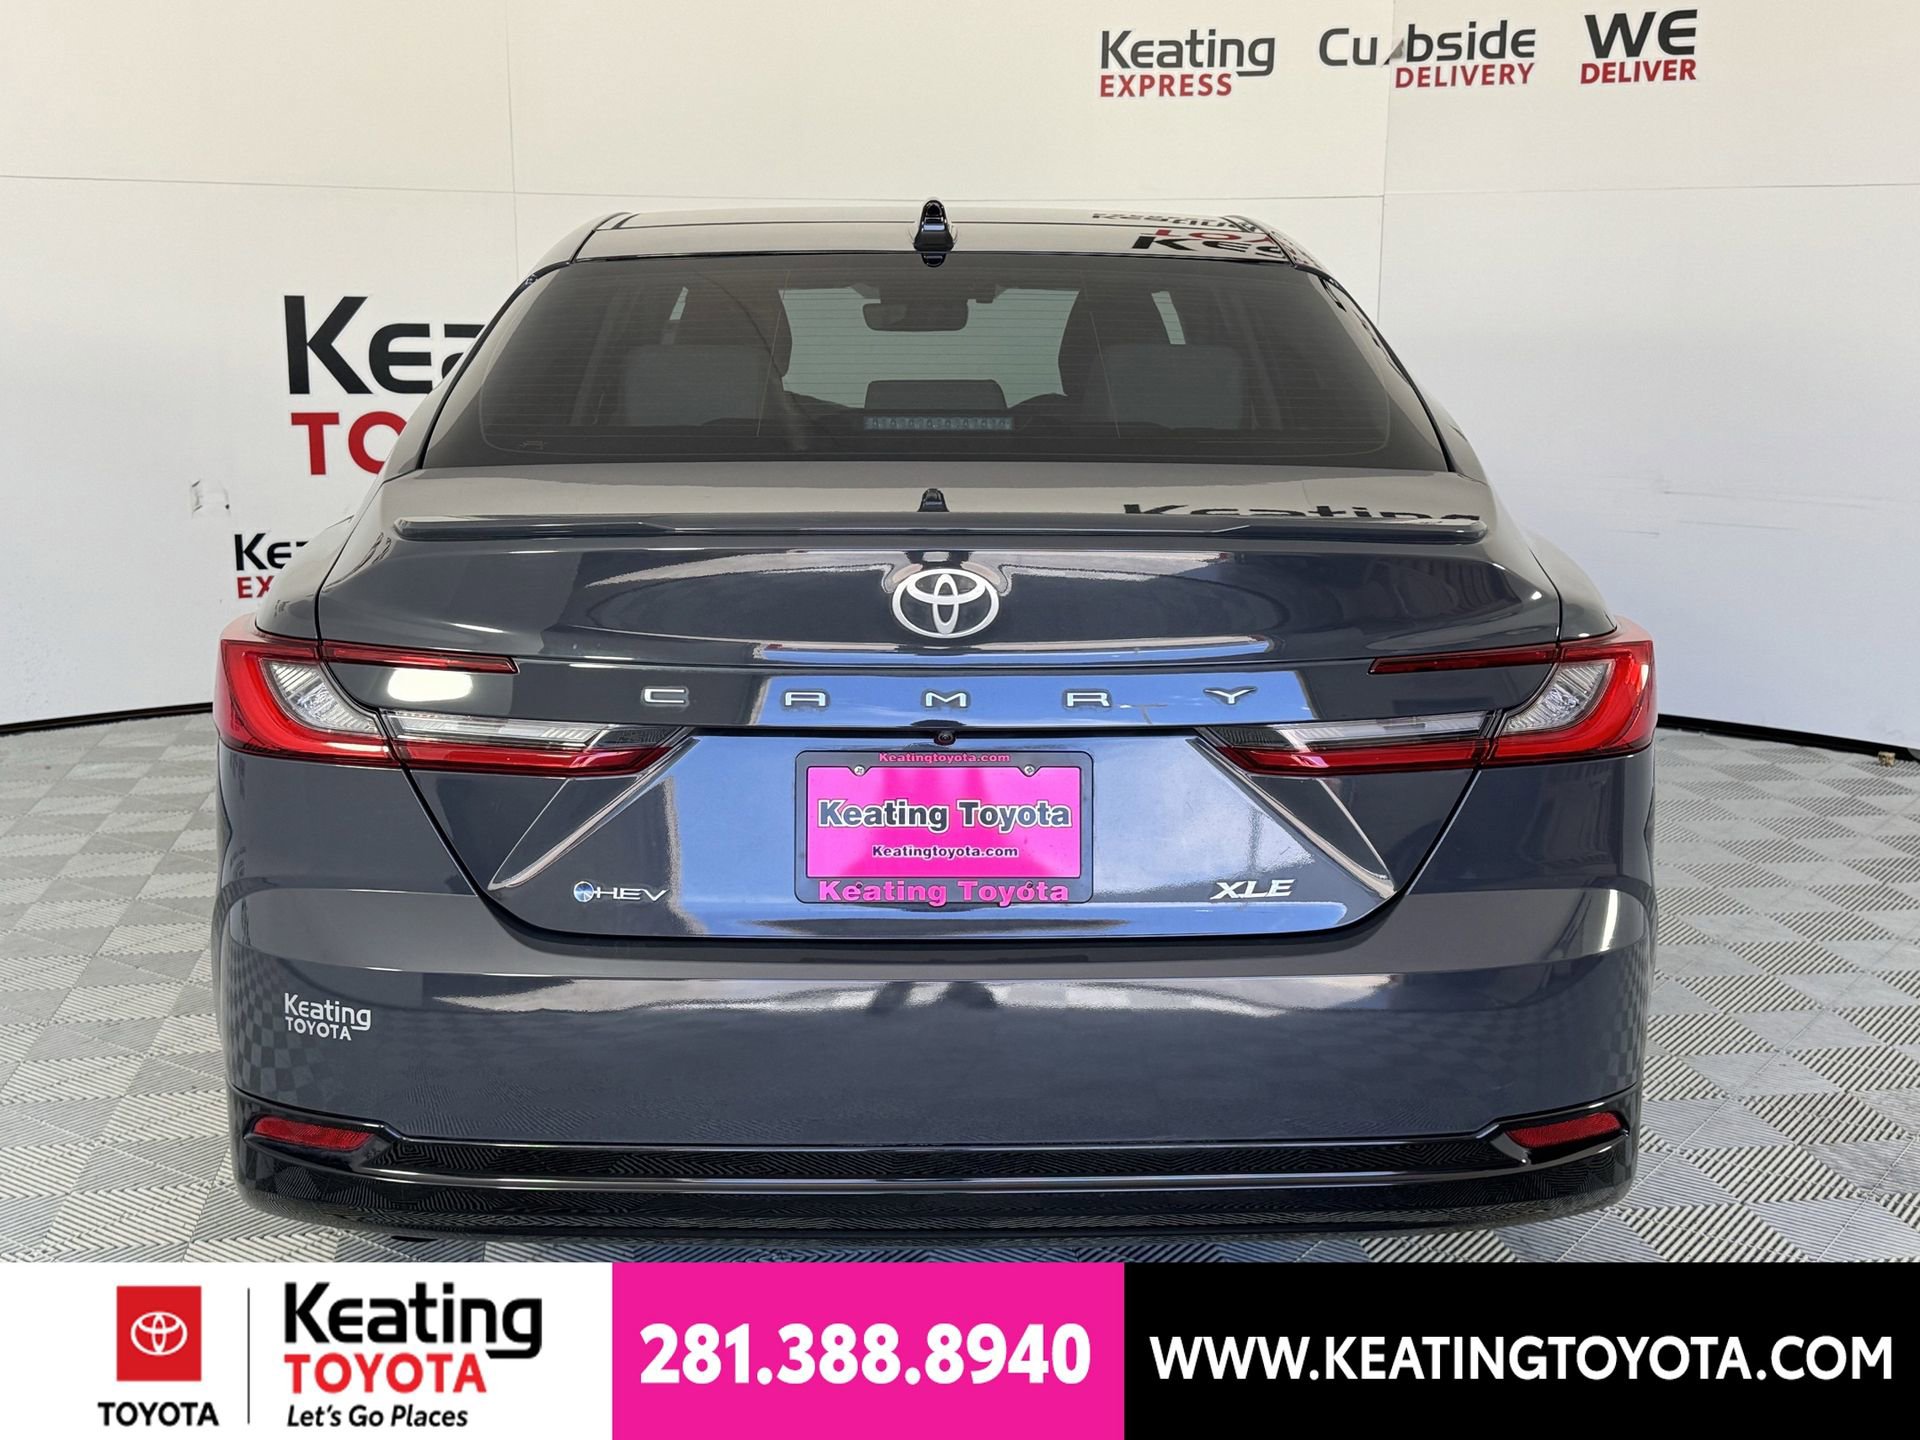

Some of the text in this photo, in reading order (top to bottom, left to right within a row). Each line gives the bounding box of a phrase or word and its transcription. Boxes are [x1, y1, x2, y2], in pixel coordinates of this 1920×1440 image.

[1319, 20, 1536, 67] Cubside
[1585, 9, 1698, 58] WE
[1101, 29, 1275, 77] Keating
[1395, 63, 1535, 88] DELIVERY
[1581, 59, 1697, 84] DELIVER
[1100, 73, 1232, 97] EXPRESS
[643, 685, 1258, 706] CAMRY
[879, 752, 1010, 764] Keatingtoyota.com
[818, 798, 1073, 834] Keating Toyota
[872, 845, 1018, 860] Keatingtoyota.com
[593, 886, 669, 902] HEV
[818, 880, 1070, 908] Keating Toyota
[1209, 878, 1296, 900] XLE
[284, 992, 372, 1031] Keating
[284, 1016, 352, 1041] TOYOTA
